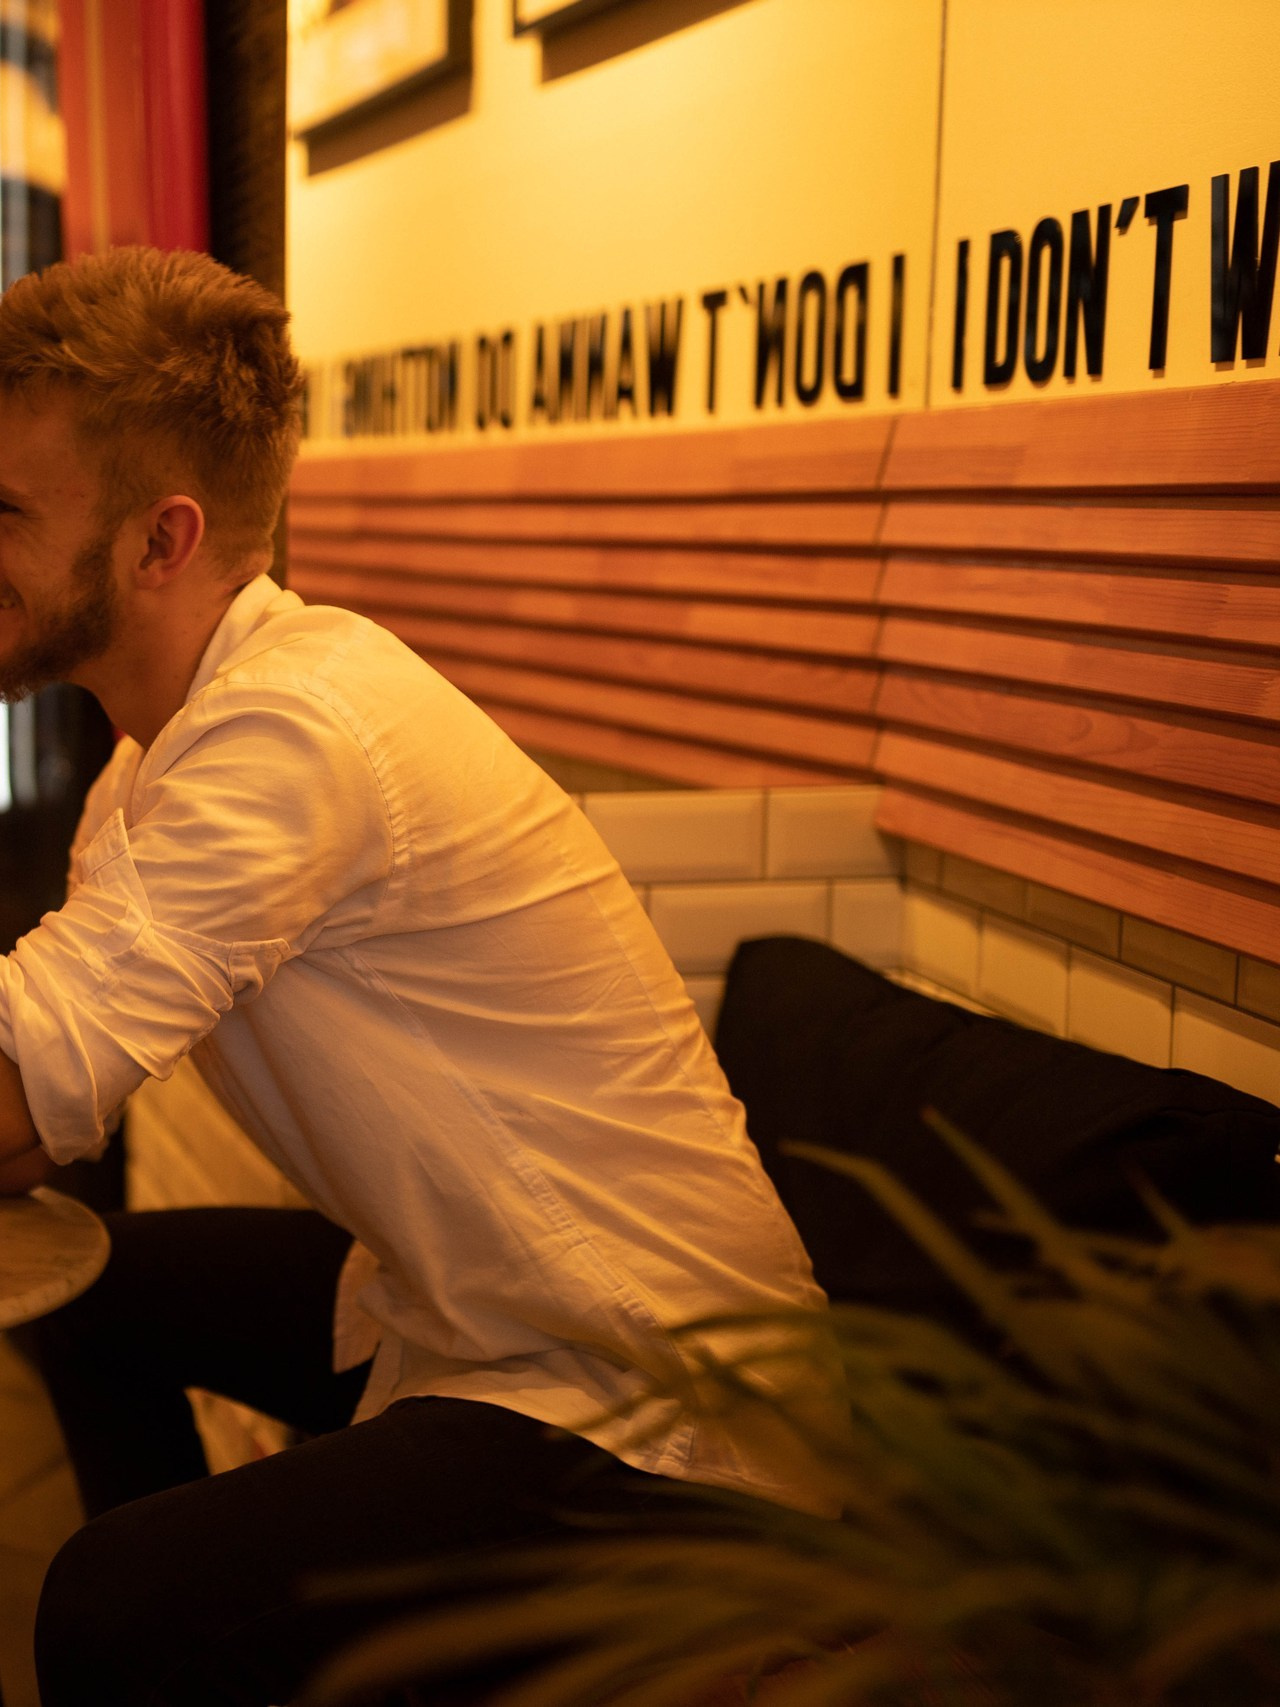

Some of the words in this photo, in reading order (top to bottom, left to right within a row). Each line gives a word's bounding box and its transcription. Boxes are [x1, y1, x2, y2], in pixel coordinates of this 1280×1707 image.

[952, 238, 971, 392] I
[983, 183, 1189, 388] DON'T
[1210, 160, 1280, 366] W
